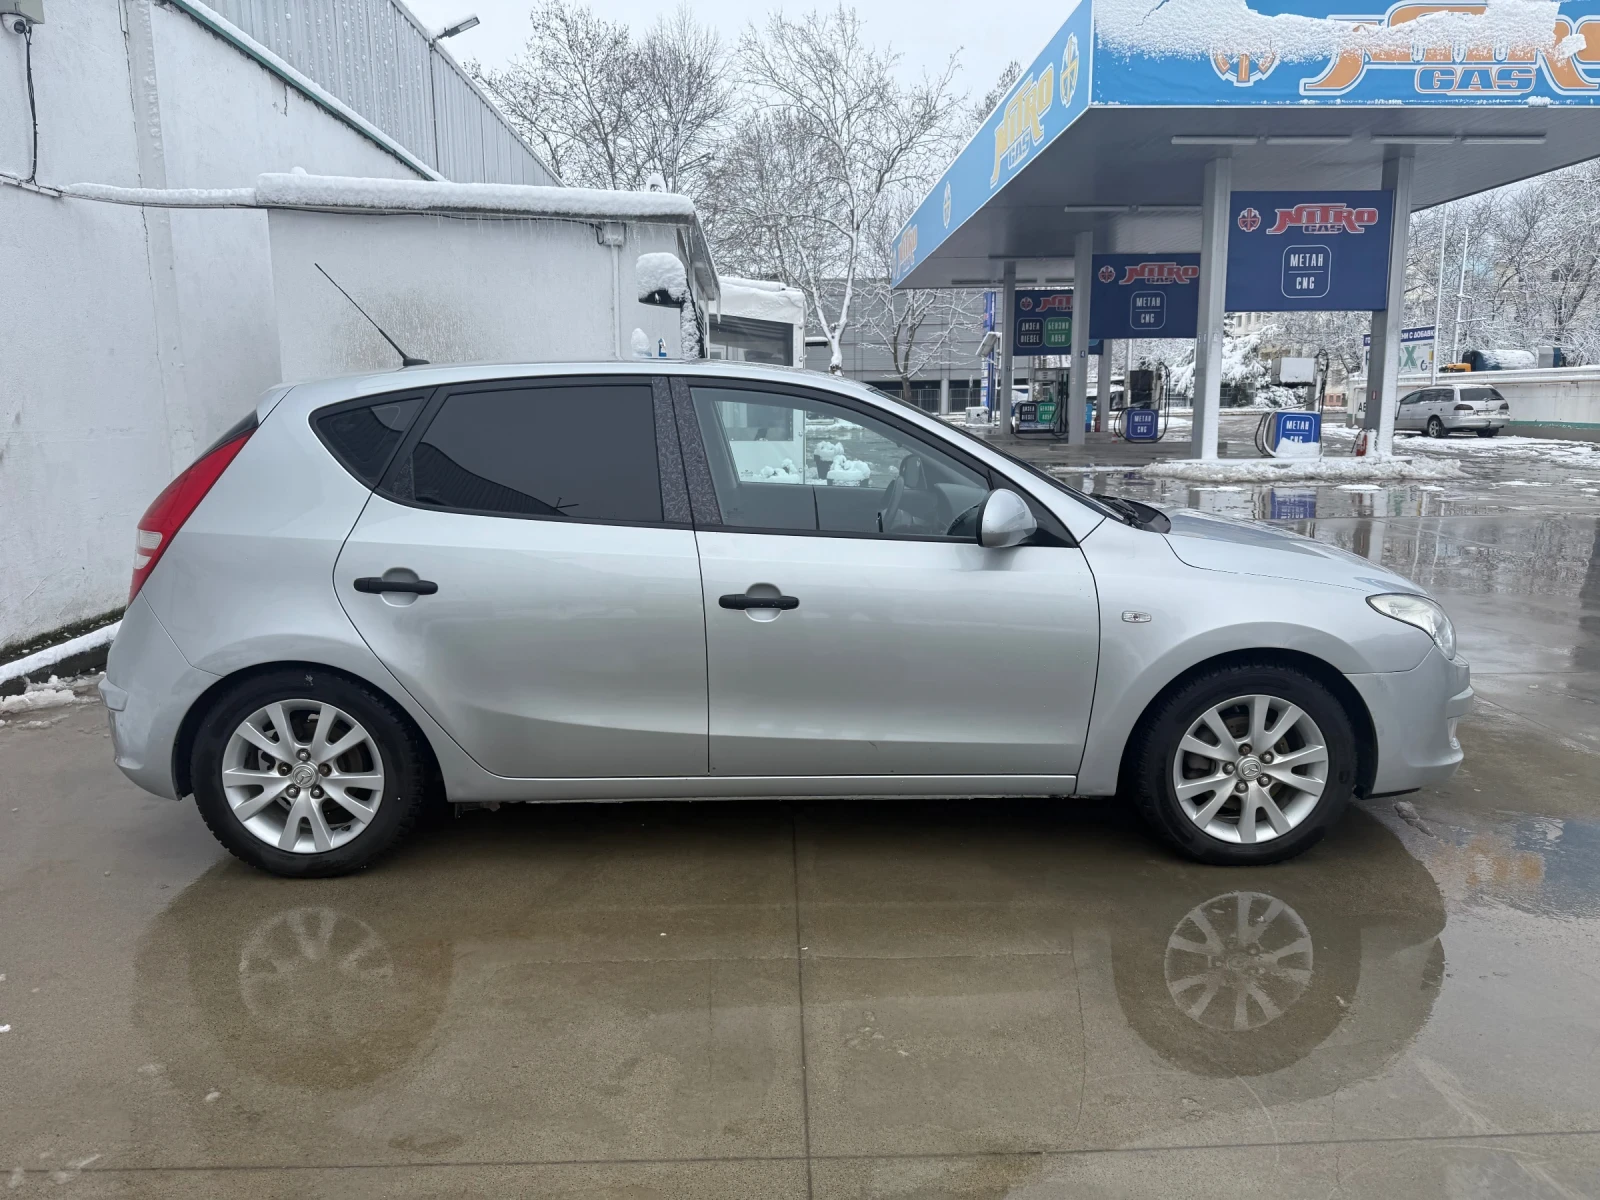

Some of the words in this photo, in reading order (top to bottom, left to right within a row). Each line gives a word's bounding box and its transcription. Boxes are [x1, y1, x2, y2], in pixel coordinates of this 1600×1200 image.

[1415, 66, 1537, 95] GAS
[1266, 203, 1378, 234] NITRO
[1118, 262, 1199, 285] NITRO
[1296, 276, 1315, 290] CNG
[1140, 313, 1155, 324] CNG
